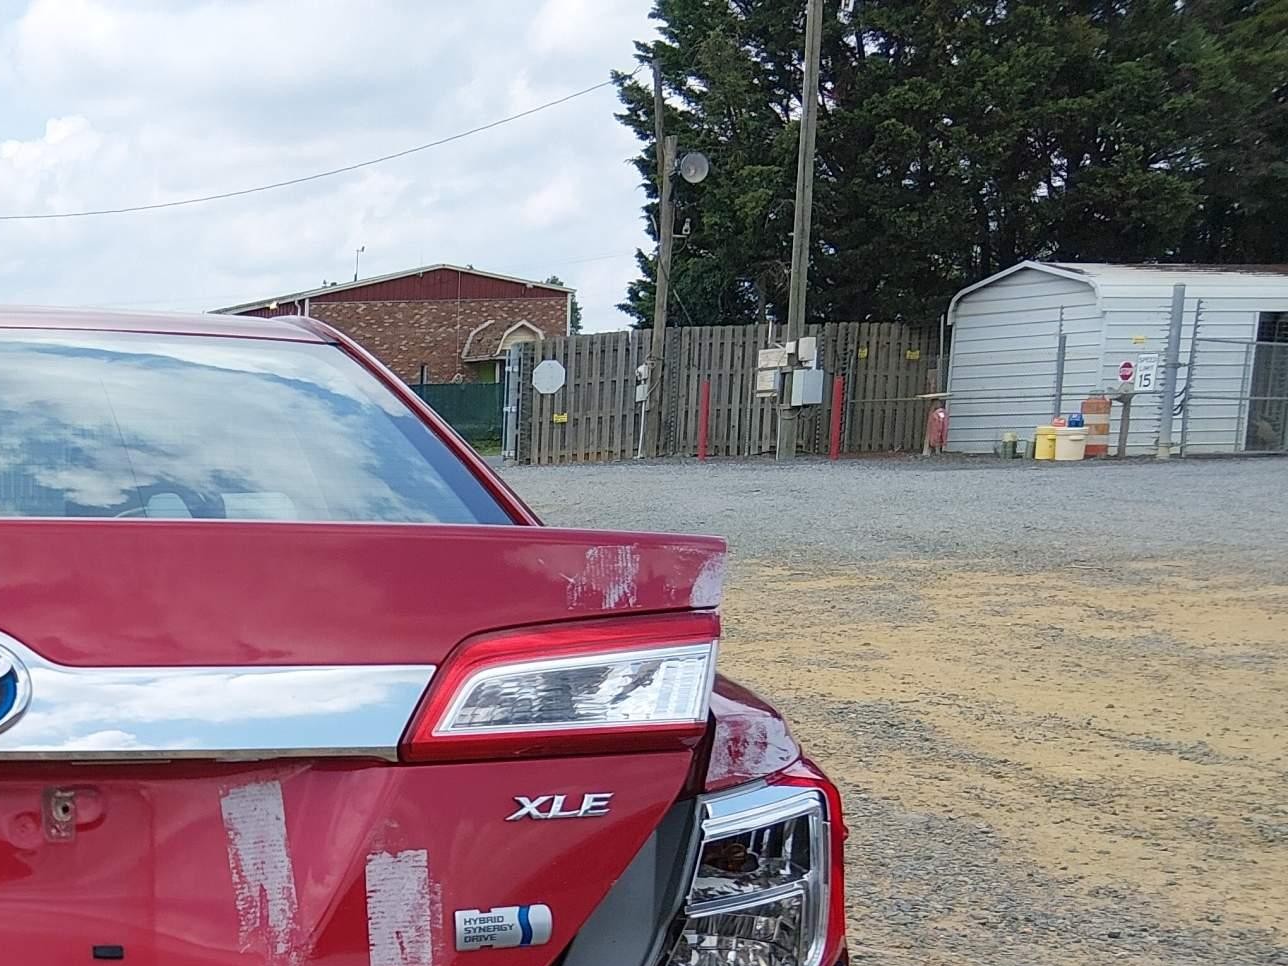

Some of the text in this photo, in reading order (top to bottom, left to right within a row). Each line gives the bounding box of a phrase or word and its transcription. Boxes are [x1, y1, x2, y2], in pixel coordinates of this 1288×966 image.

[1139, 373, 1151, 388] 15
[504, 792, 615, 821] XLE
[463, 915, 505, 926] HYBRID
[463, 923, 515, 935] SYNERGY
[463, 933, 497, 944] DRIVE
